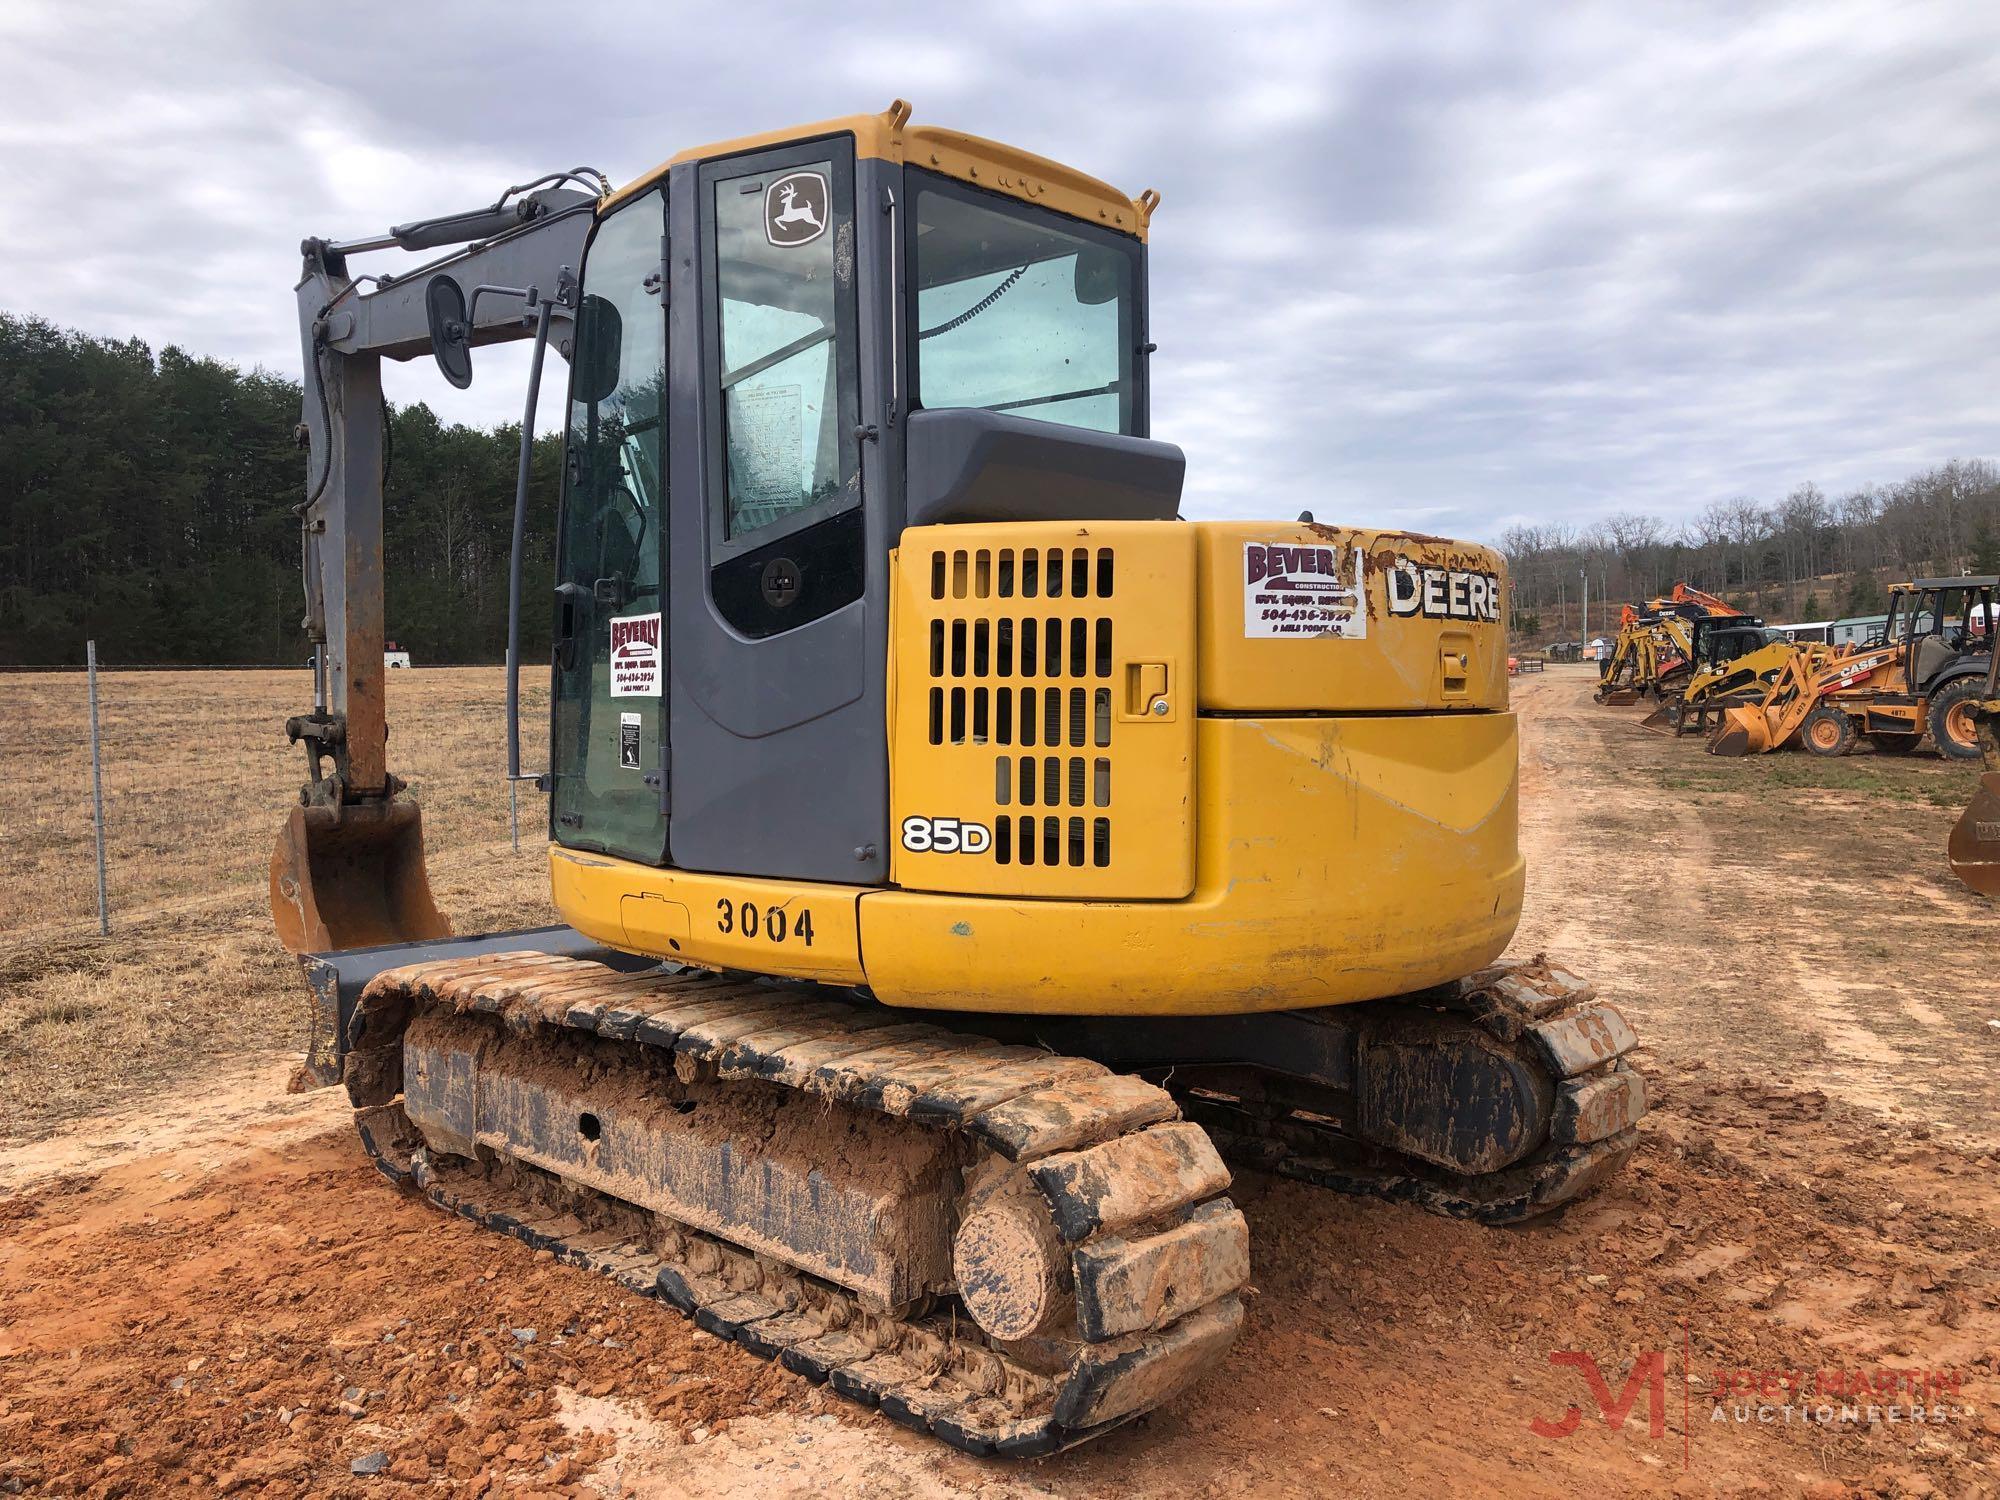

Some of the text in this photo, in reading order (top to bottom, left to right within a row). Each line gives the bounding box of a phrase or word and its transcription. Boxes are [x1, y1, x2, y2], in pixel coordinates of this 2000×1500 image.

[1248, 546, 1335, 585] BEVER
[1386, 558, 1500, 620] DEERE
[612, 618, 659, 654] BEVERLY
[1840, 656, 1878, 677] CASE
[901, 816, 991, 853] 85D
[717, 898, 814, 946] 3004
